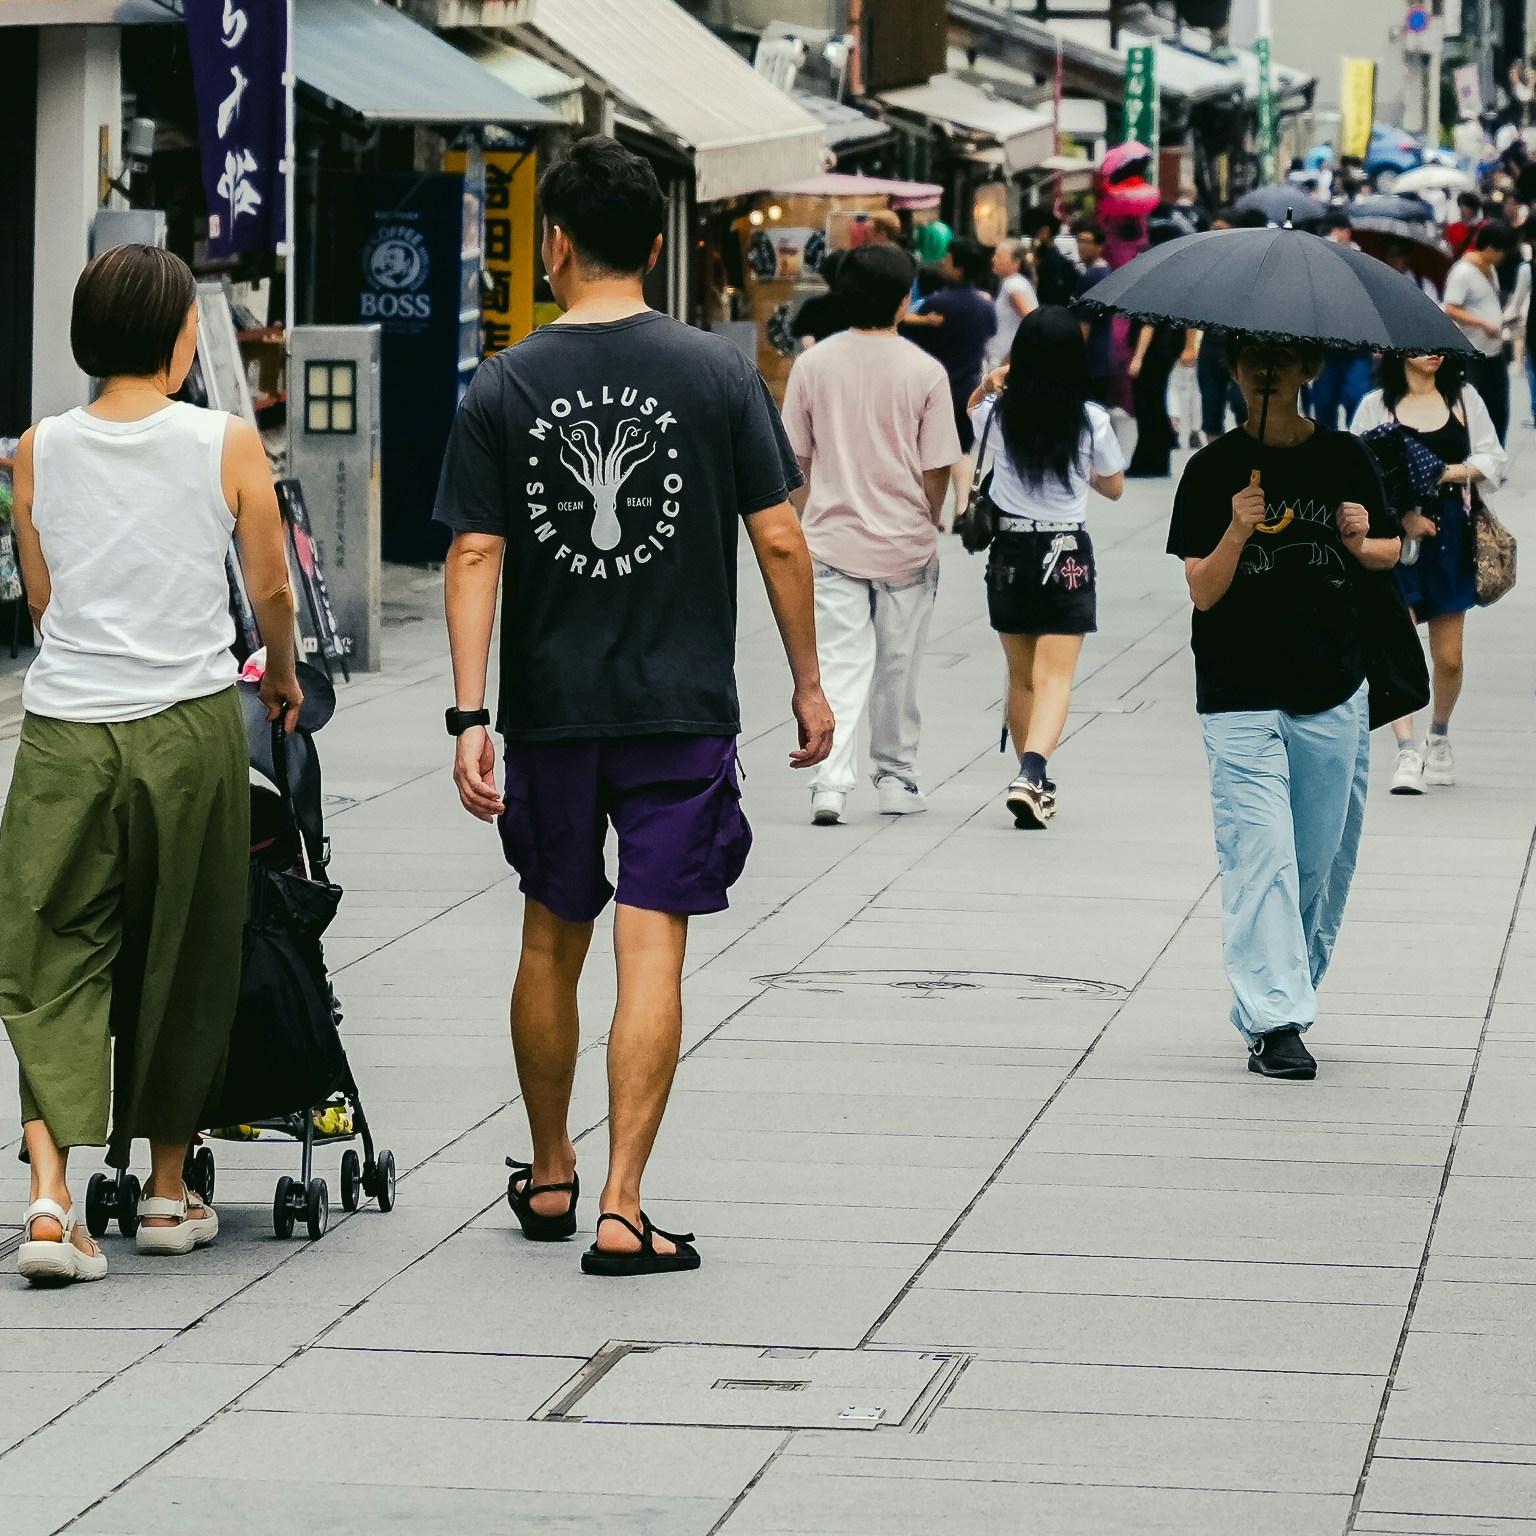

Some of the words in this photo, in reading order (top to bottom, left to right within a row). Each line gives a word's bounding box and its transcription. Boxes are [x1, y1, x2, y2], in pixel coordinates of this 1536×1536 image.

[360, 292, 432, 318] BOSS
[528, 385, 678, 441] MOLLUSK
[557, 501, 584, 511] OCEAN
[626, 497, 652, 507] BEACH
[526, 481, 557, 543] SAN
[554, 473, 683, 579] FRANCISCO
